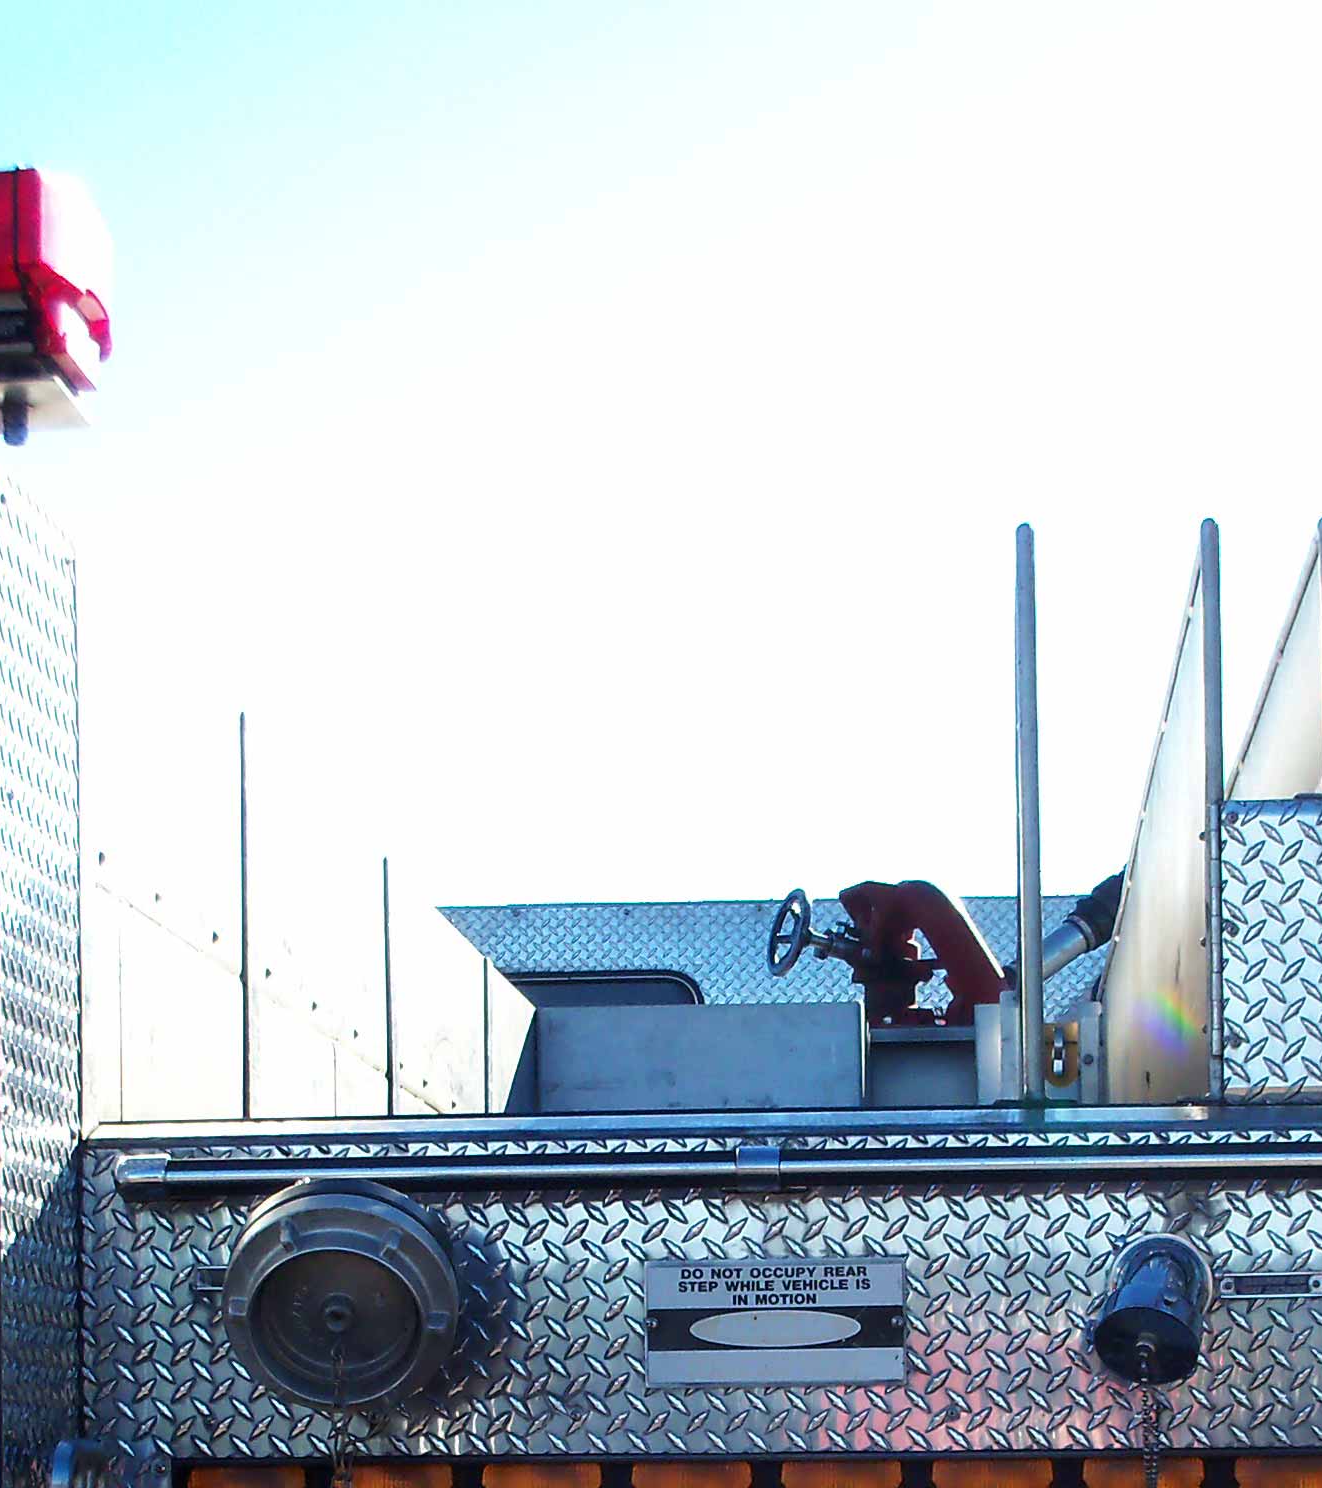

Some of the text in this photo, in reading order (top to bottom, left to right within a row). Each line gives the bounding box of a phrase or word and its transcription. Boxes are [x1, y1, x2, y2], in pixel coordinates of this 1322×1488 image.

[680, 1265, 867, 1280] DO NOT OCCUPY REAR
[678, 1278, 871, 1293] STEP WHILE VEHICLE IS
[732, 1293, 817, 1306] IN MOTION
